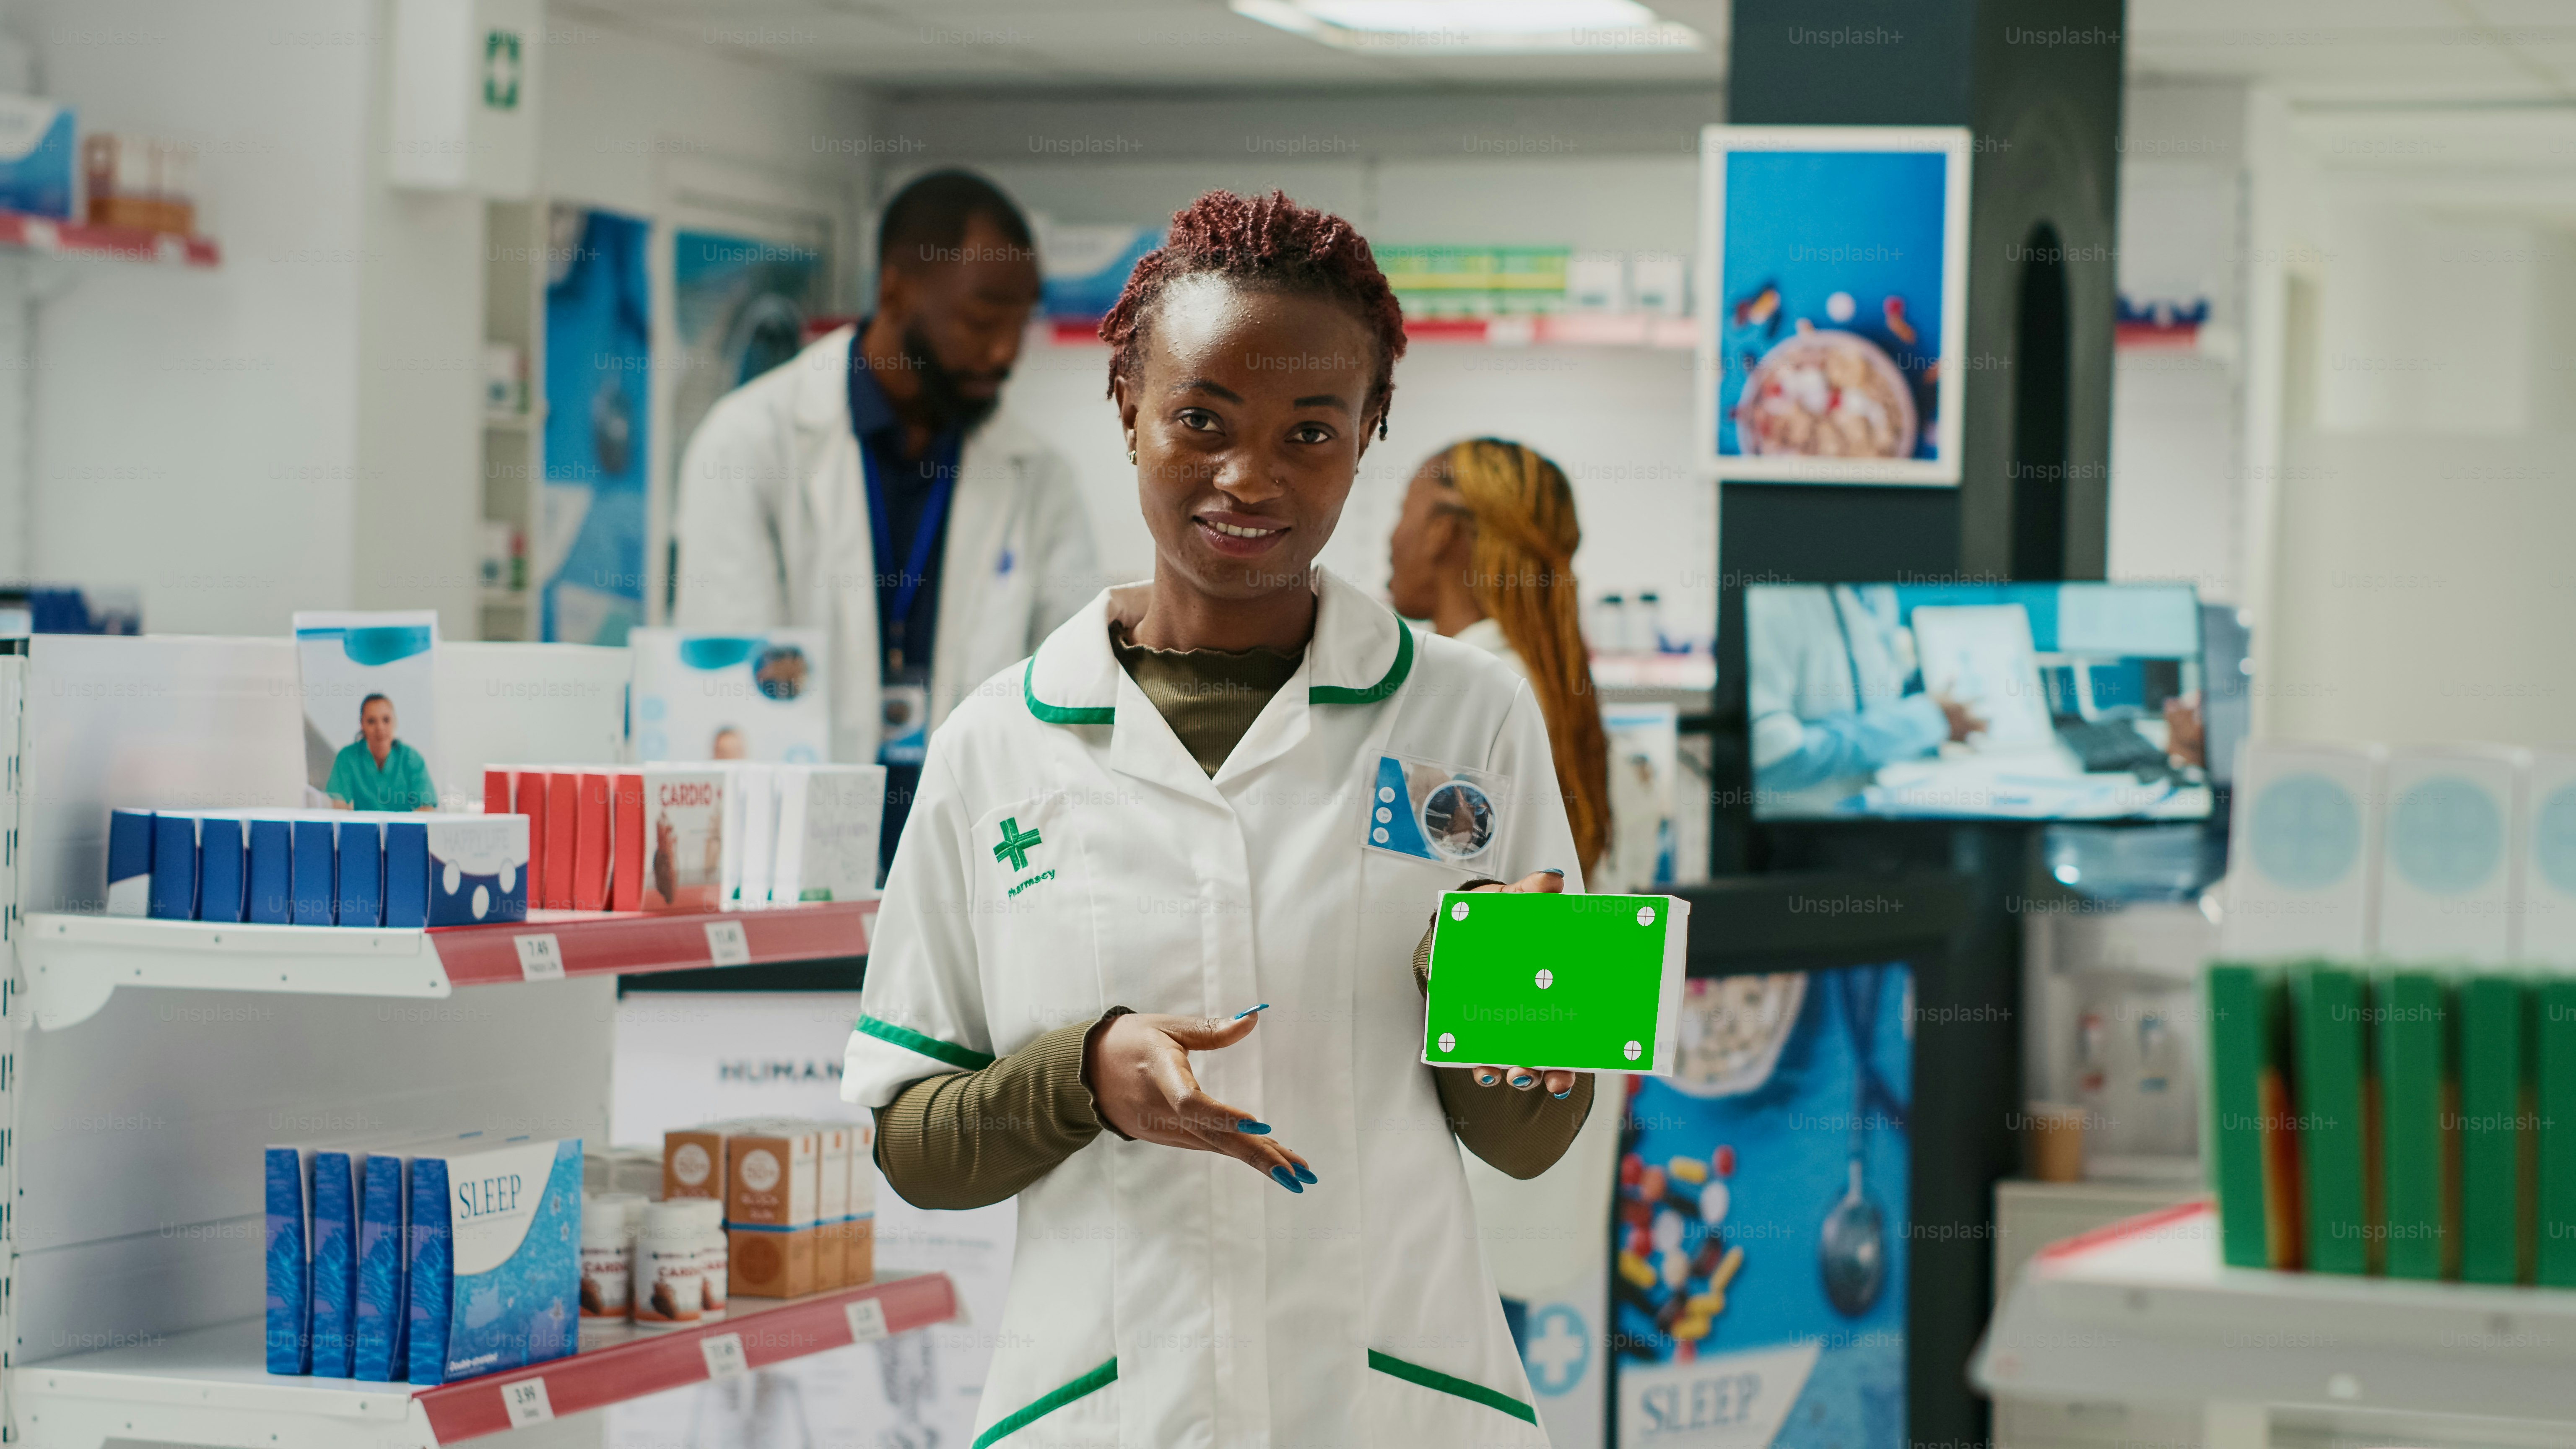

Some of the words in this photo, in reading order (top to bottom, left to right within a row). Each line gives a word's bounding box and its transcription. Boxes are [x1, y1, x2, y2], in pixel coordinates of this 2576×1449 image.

[660, 782, 712, 807] CARDIO
[1008, 869, 1055, 900] Pharmacy
[459, 1174, 521, 1219] SLEEP
[1640, 1371, 1762, 1437] SLEEP
